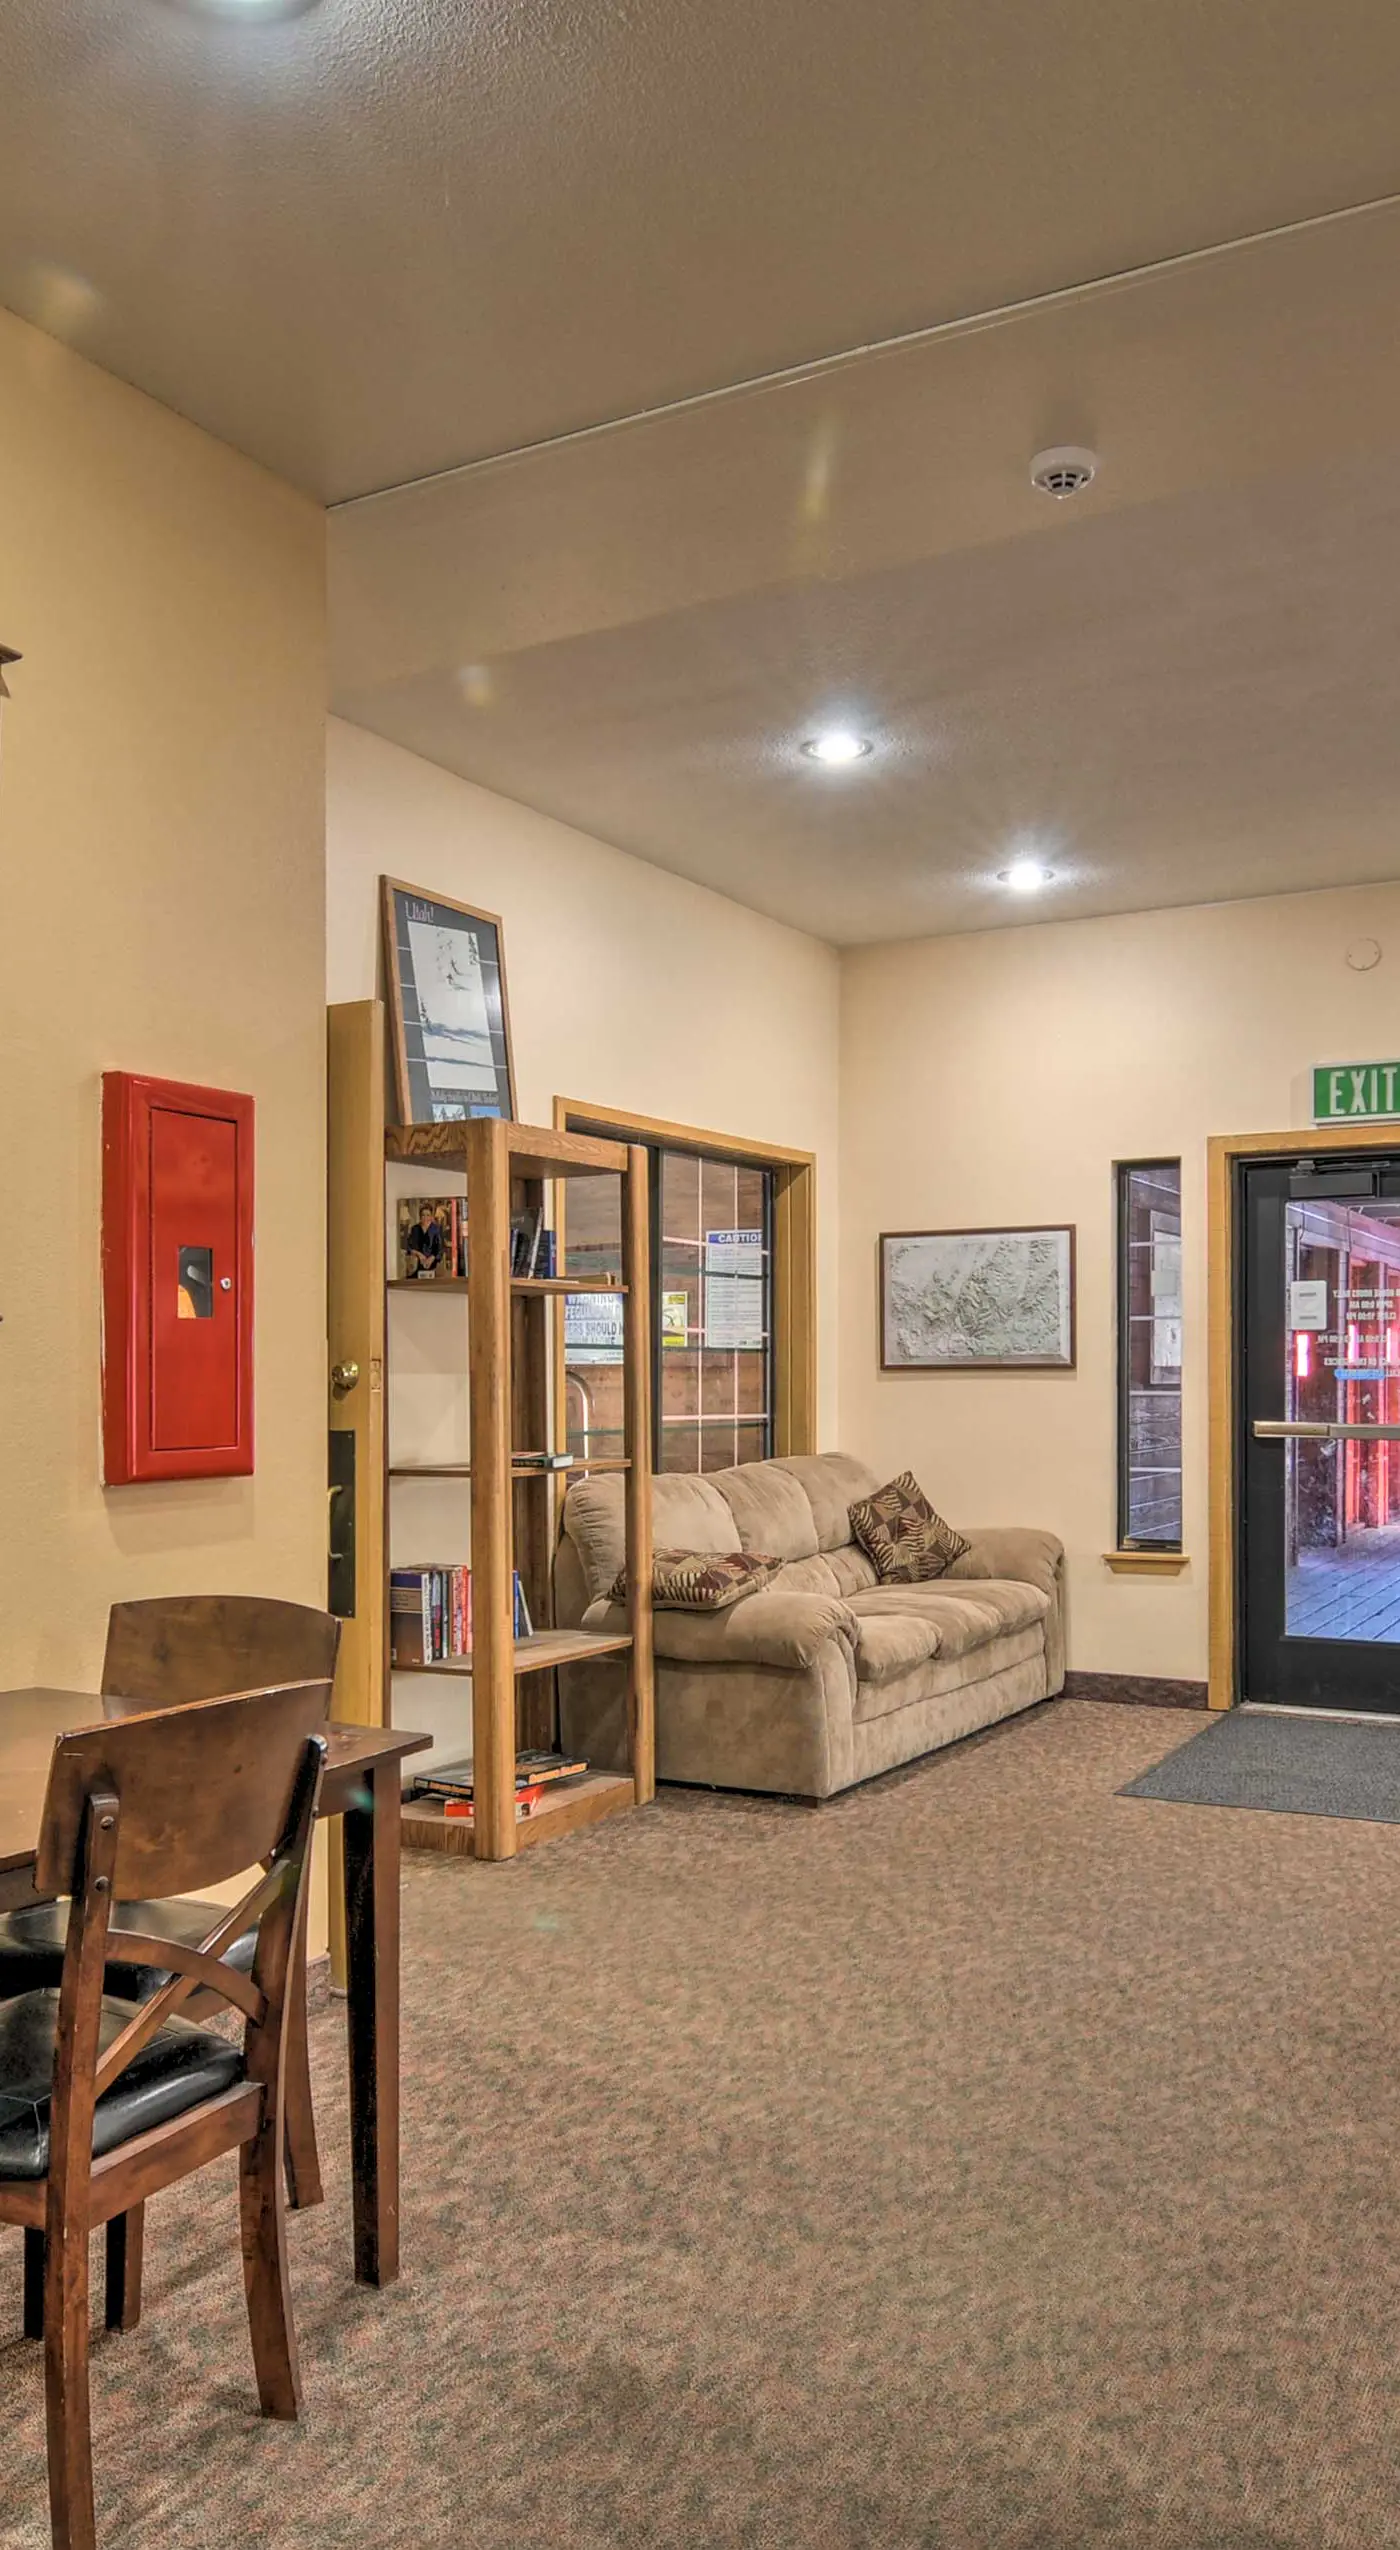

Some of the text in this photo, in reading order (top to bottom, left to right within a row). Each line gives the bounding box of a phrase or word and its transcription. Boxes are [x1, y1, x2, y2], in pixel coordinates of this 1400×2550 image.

[404, 900, 434, 923] Utah!
[1329, 1066, 1398, 1115] EXIT
[586, 1321, 617, 1336] SHOULD
